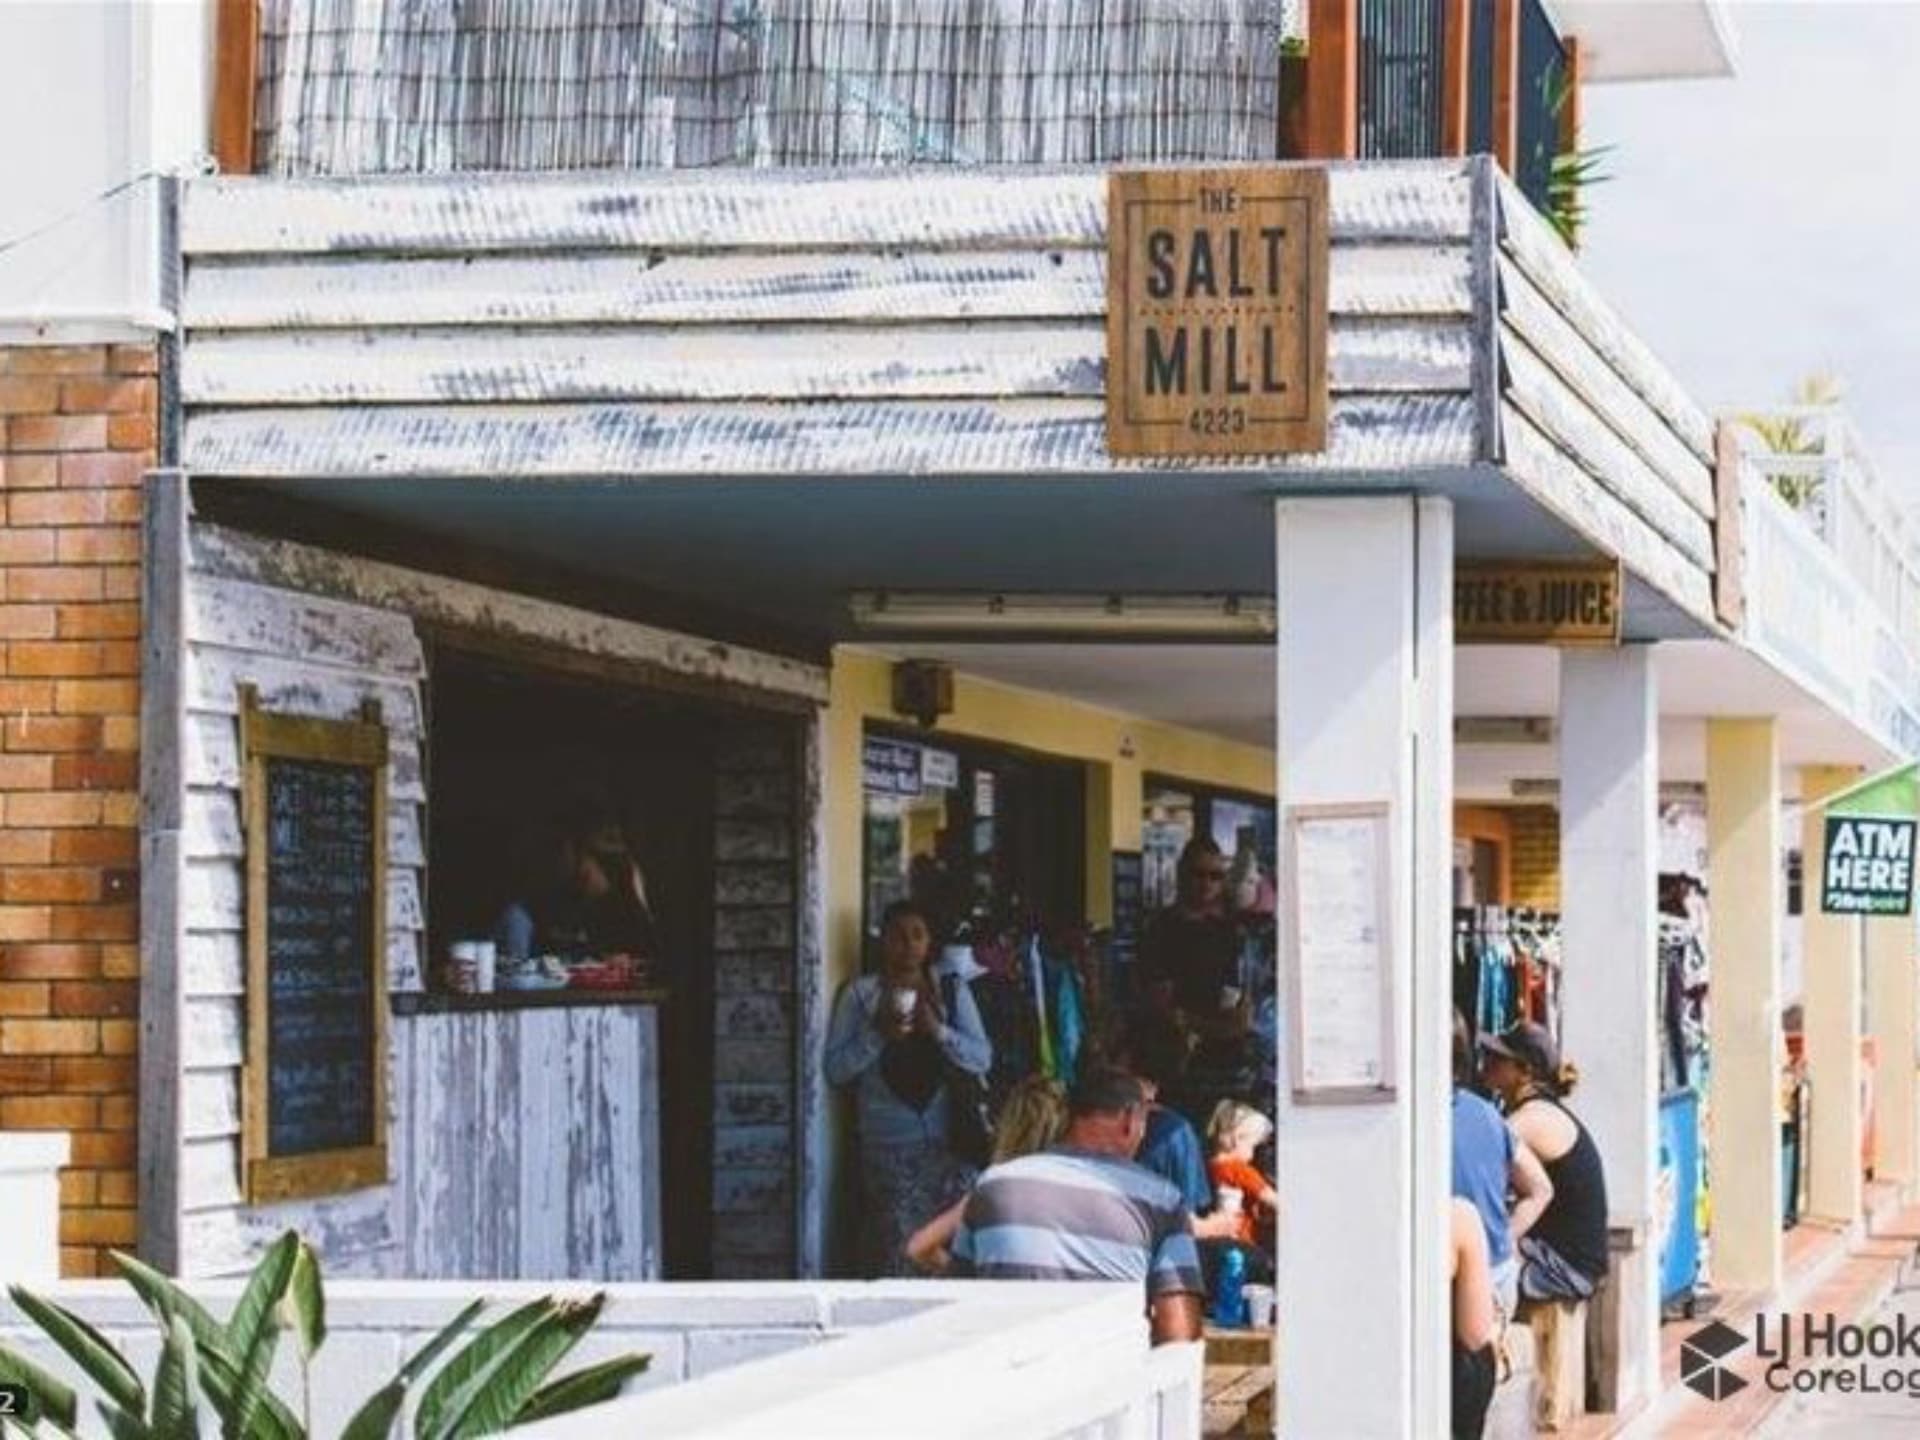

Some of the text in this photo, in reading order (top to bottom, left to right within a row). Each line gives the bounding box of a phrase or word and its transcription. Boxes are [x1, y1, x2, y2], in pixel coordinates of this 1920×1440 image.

[1199, 187, 1237, 212] THE
[1146, 227, 1287, 298] SALT
[1144, 325, 1288, 396] MILL
[1188, 406, 1246, 435] 4223
[1537, 579, 1611, 625] JUICE
[1830, 821, 1913, 858] ATM
[1828, 856, 1910, 891] HERE
